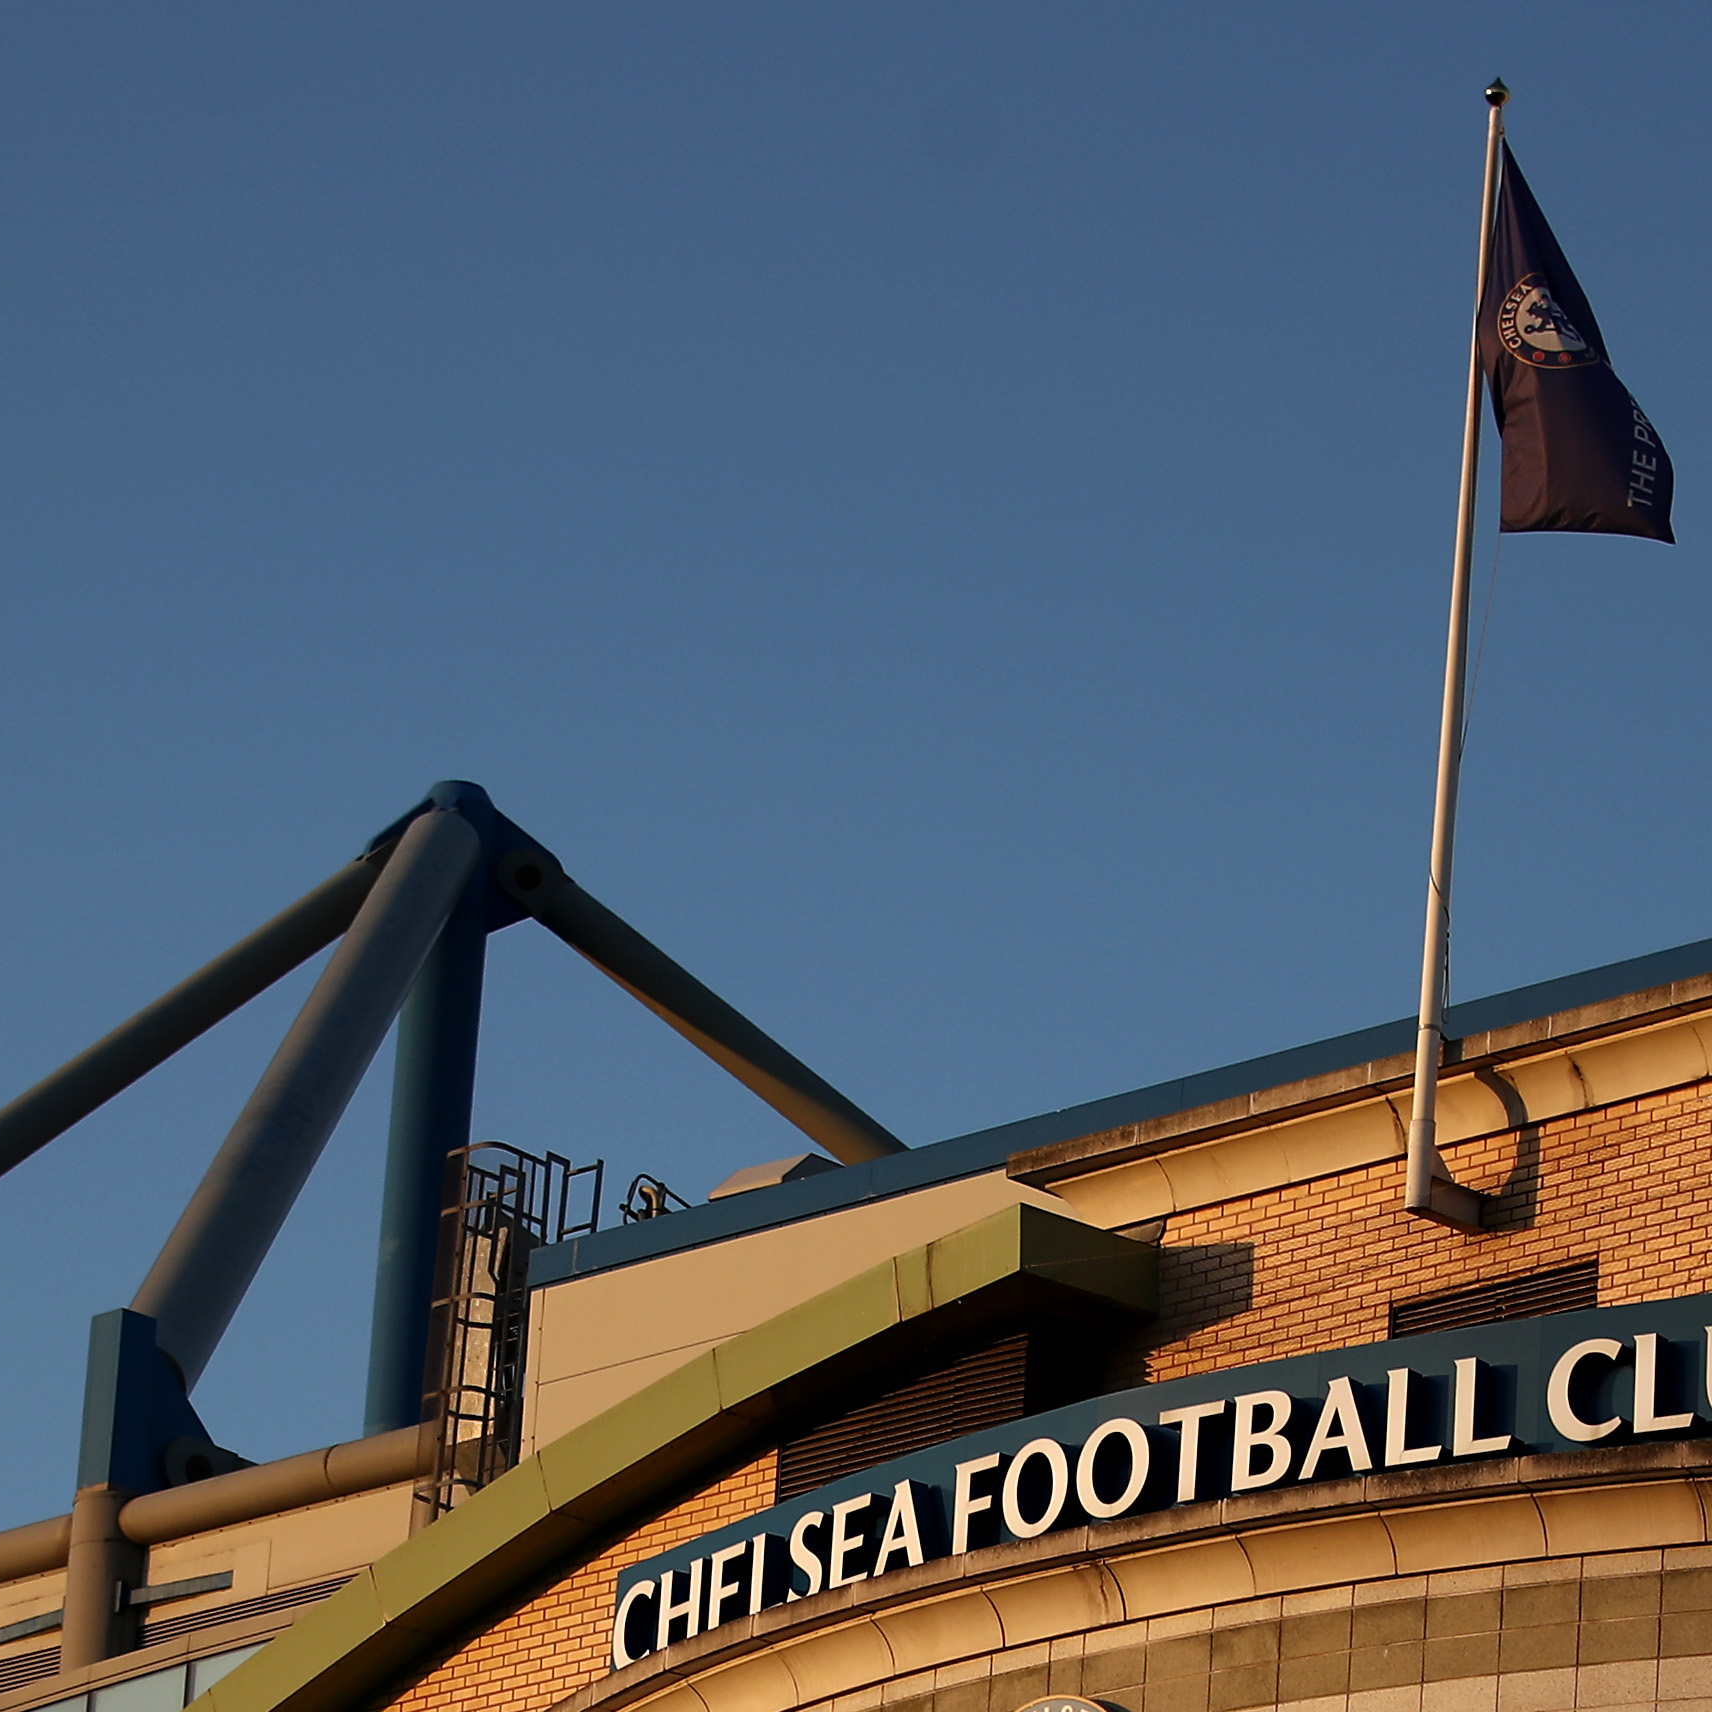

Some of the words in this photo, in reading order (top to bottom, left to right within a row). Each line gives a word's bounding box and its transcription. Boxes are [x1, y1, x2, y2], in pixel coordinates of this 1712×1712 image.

[1501, 284, 1532, 349] CHELSEA
[1627, 450, 1656, 508] THE
[612, 1478, 924, 1670] CHELSEA
[952, 1356, 1513, 1556] FOOTBALL
